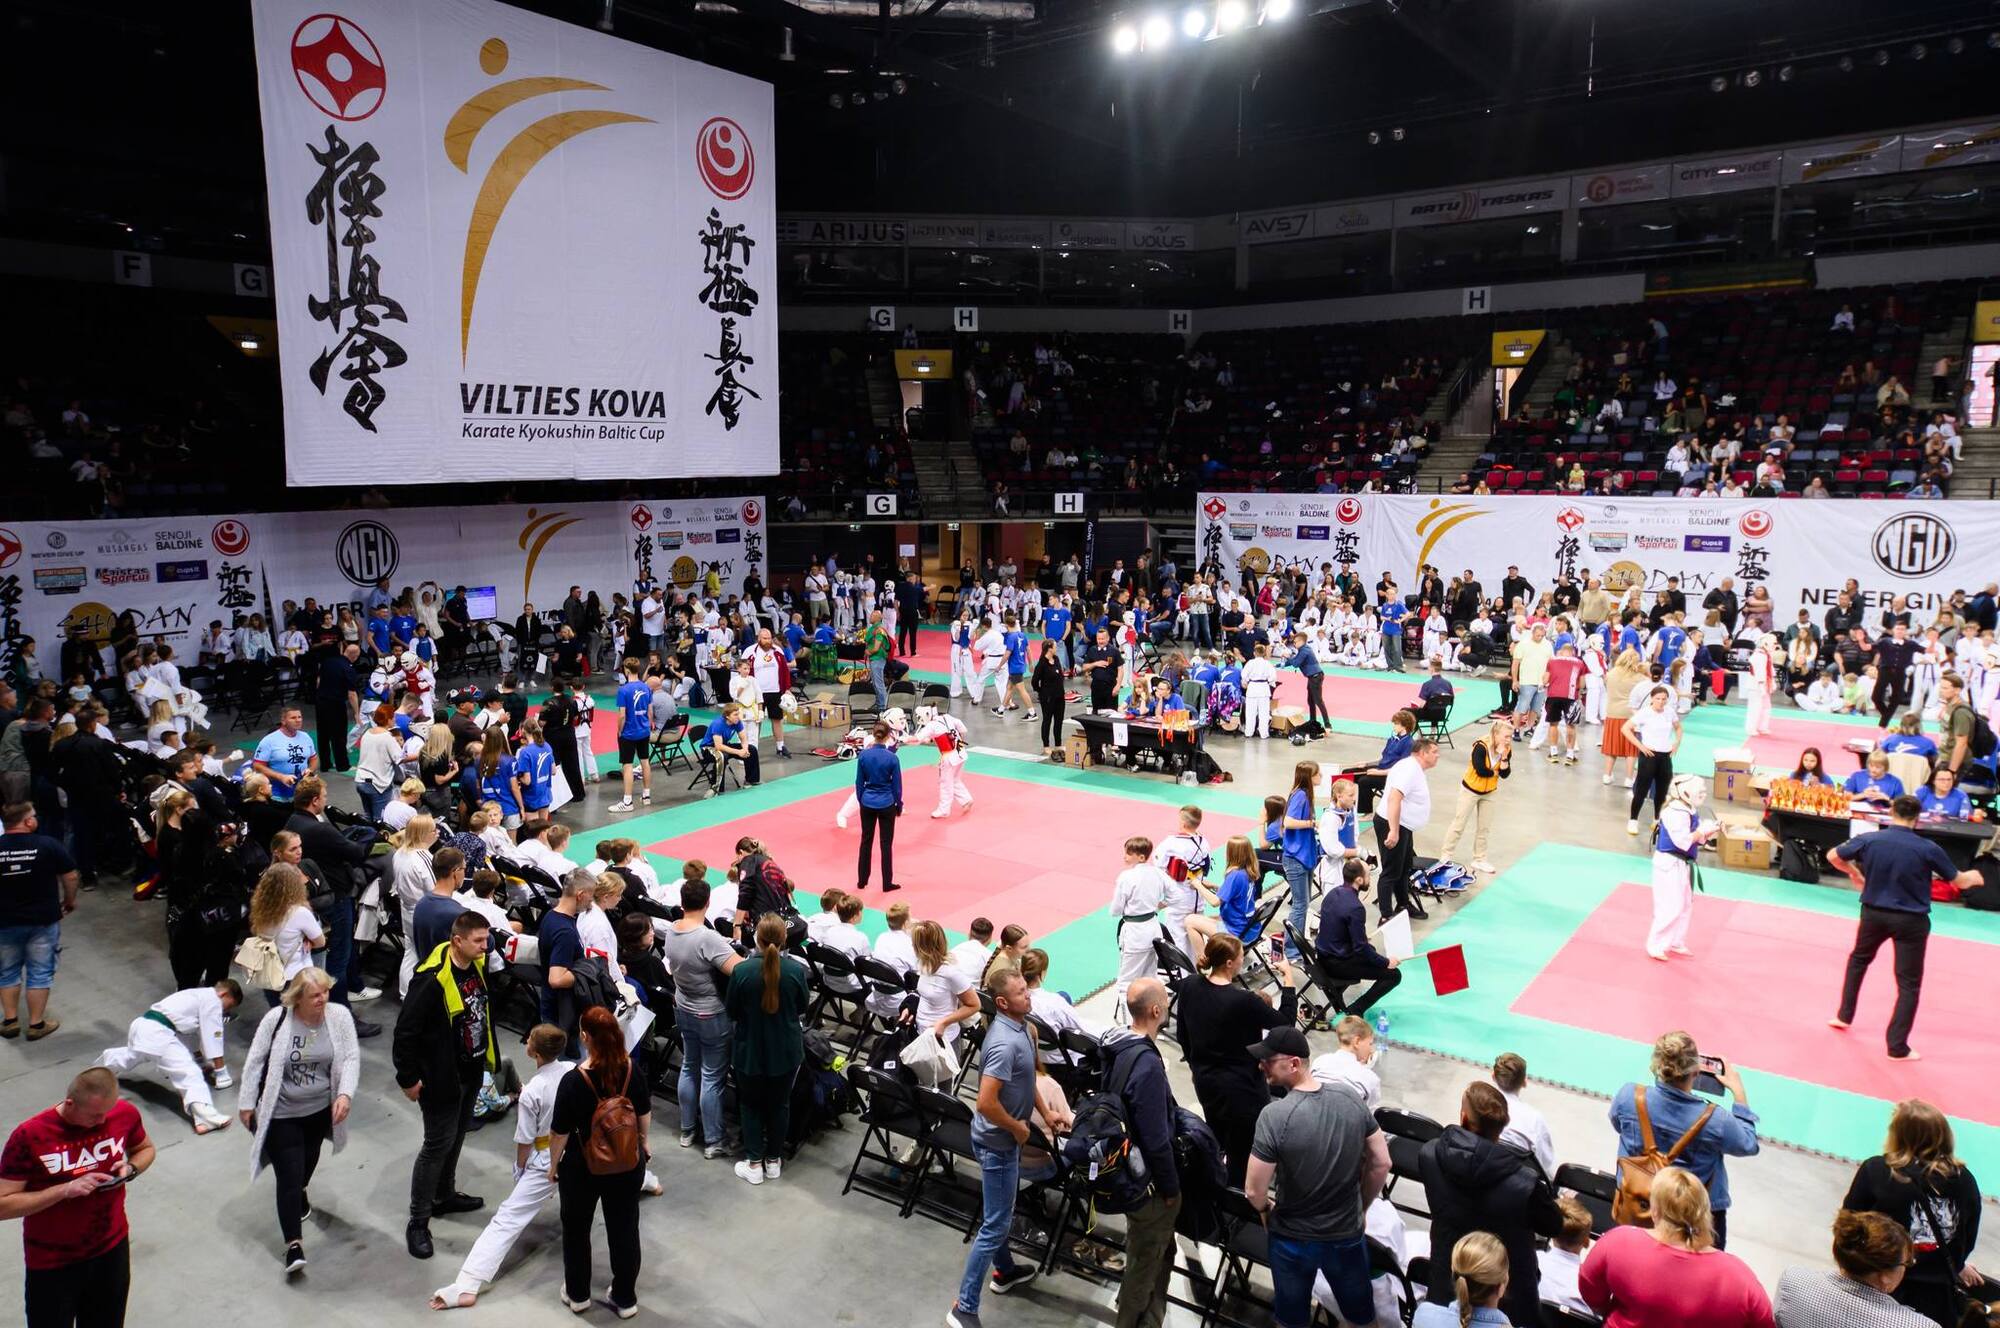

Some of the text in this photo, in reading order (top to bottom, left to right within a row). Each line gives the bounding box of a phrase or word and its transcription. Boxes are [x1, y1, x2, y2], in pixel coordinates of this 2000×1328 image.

[811, 222, 905, 241] ARIJUS
[122, 255, 141, 279] F
[241, 268, 262, 291] G
[1469, 290, 1485, 309] H
[875, 309, 891, 327] G
[959, 310, 973, 327] H
[1173, 314, 1187, 330] H
[460, 382, 666, 418] VILTIES KOVA
[462, 423, 665, 443] Karate Kyokushin Baltic Cup
[874, 496, 891, 513] G
[1062, 494, 1076, 512] H
[342, 527, 393, 581] NGU
[1878, 518, 1948, 572] NGU
[1801, 588, 1896, 608] NEER
[39, 1135, 125, 1175] BLACK
